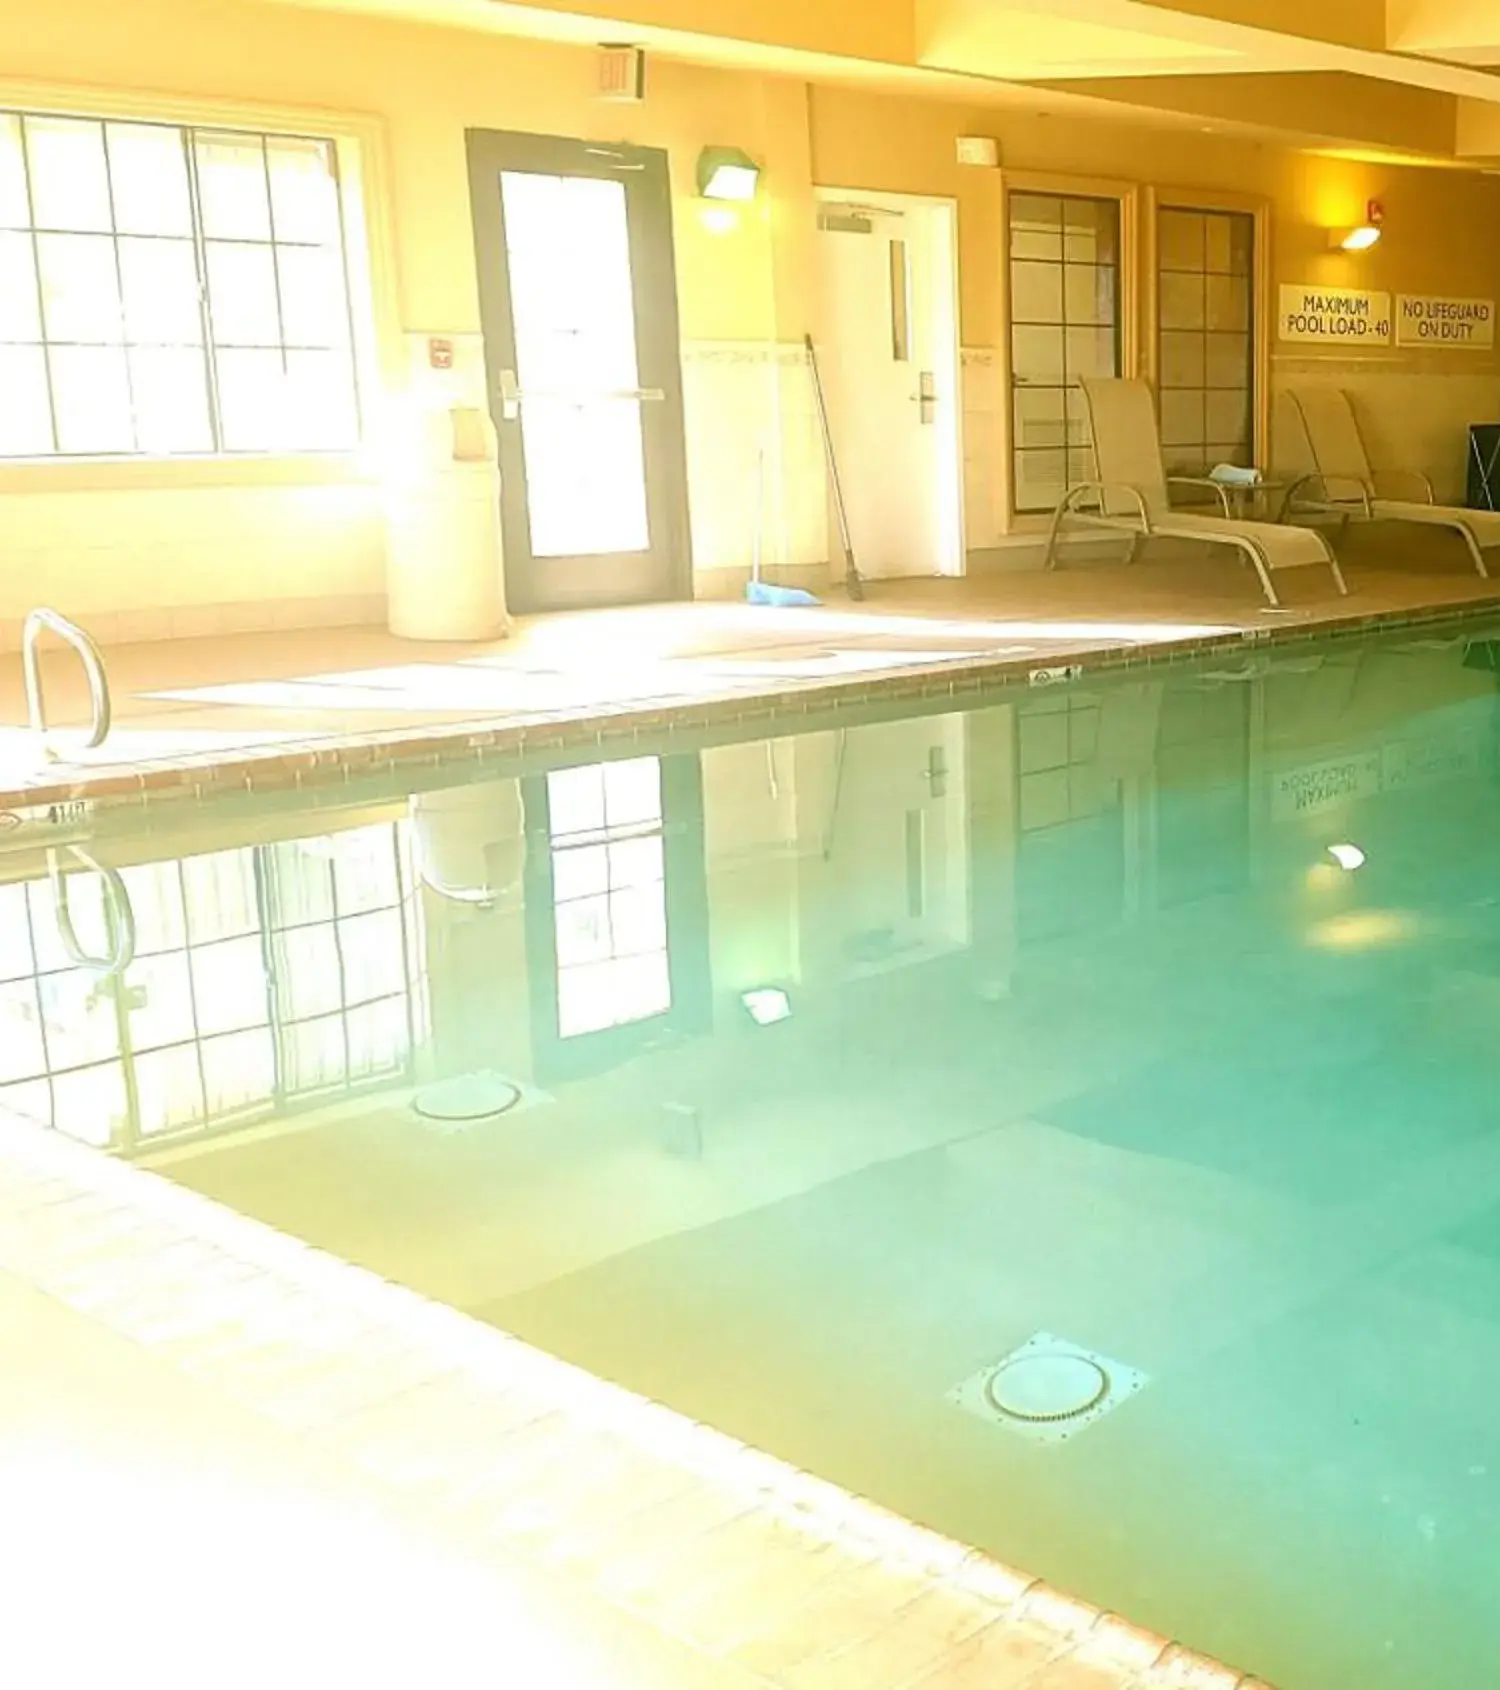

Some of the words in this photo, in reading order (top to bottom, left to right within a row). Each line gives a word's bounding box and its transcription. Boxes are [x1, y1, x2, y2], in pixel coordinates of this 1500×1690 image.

[1303, 295, 1369, 315] MAXIMUM
[1403, 301, 1423, 319] NO
[1427, 302, 1489, 321] LIFEGUARD
[1287, 315, 1326, 334] POOL
[1418, 320, 1440, 338] ON
[1442, 322, 1475, 340] DUTY
